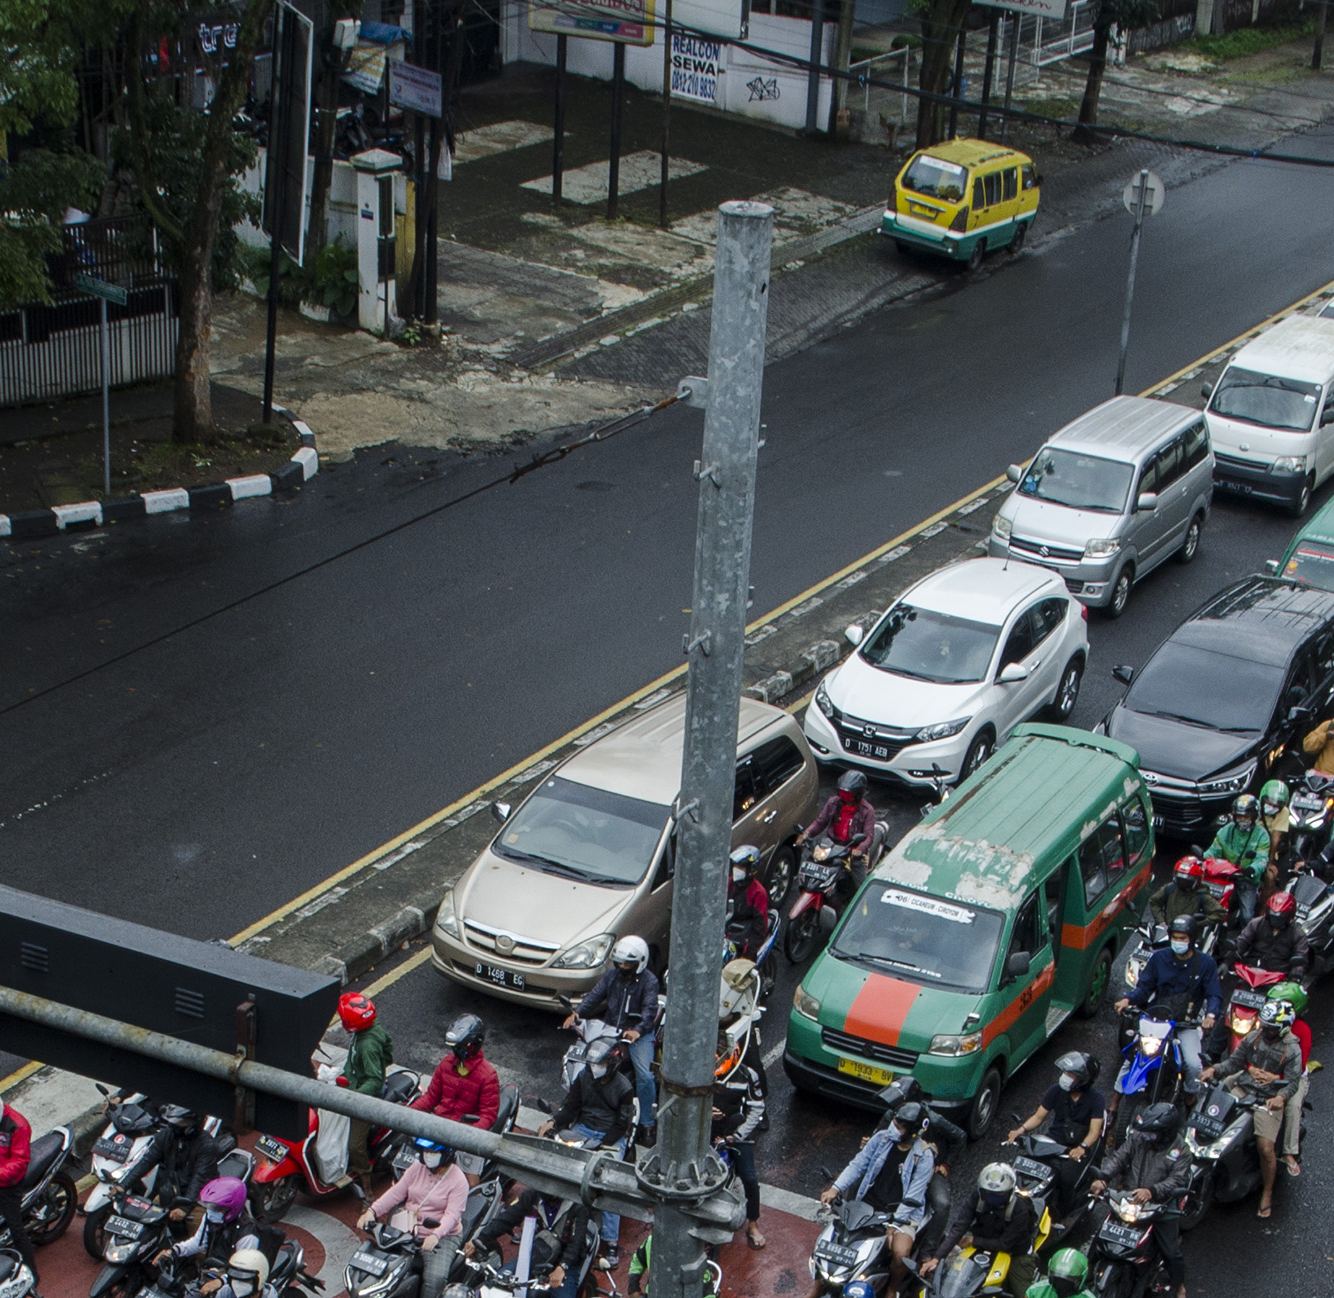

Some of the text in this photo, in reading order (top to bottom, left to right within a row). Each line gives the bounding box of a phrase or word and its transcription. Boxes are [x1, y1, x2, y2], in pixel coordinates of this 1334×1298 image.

[673, 35, 720, 61] REALCON
[673, 55, 716, 76] SEWA
[854, 1062, 873, 1076] 1933
